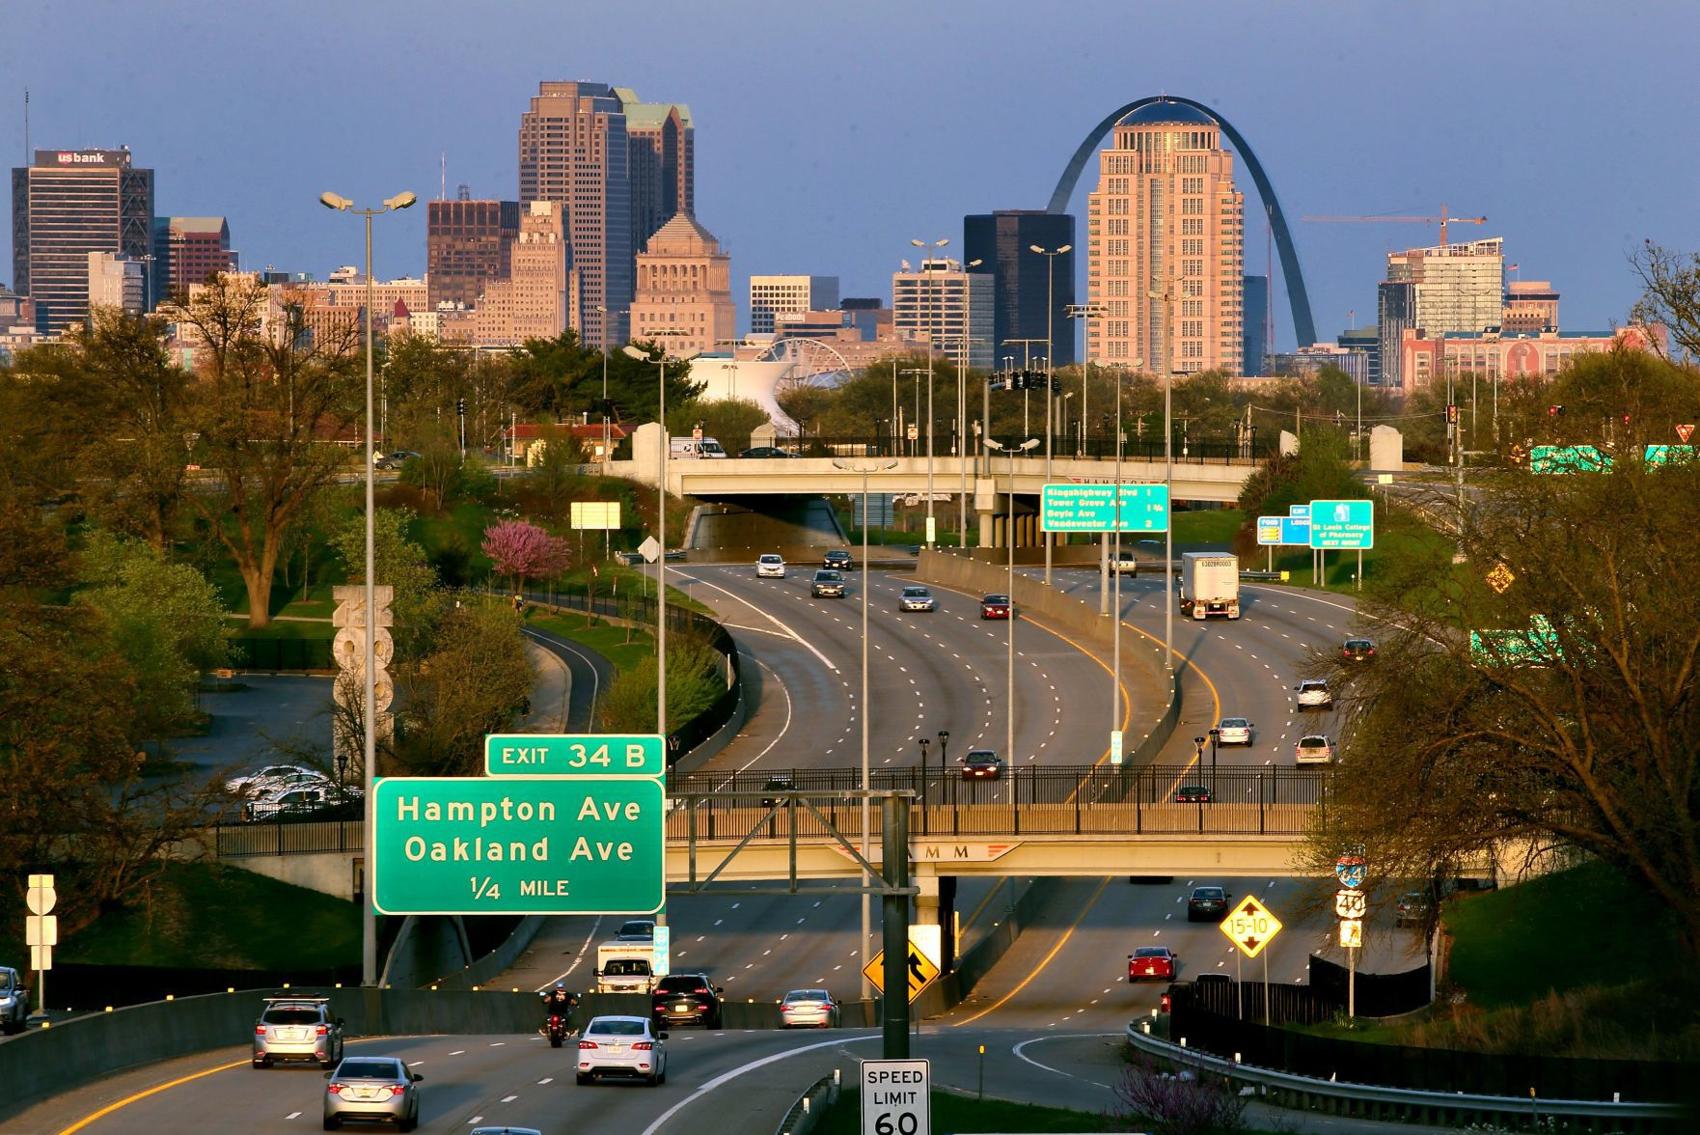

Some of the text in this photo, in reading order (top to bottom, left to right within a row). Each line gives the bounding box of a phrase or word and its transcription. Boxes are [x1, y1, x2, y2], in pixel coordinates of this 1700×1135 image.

[1048, 498, 1074, 507] Tower
[1078, 498, 1105, 507] Grove
[1078, 509, 1096, 517] Ave
[1048, 519, 1106, 528] Vandeventer
[502, 744, 645, 768] EXIT 34 B
[397, 796, 641, 828] Hampton Ave
[404, 836, 634, 861] Oakland Ave
[520, 880, 569, 896] MILE
[868, 1071, 923, 1084] SPEED
[874, 1092, 917, 1105] LIMIT
[875, 1112, 918, 1135] 60
